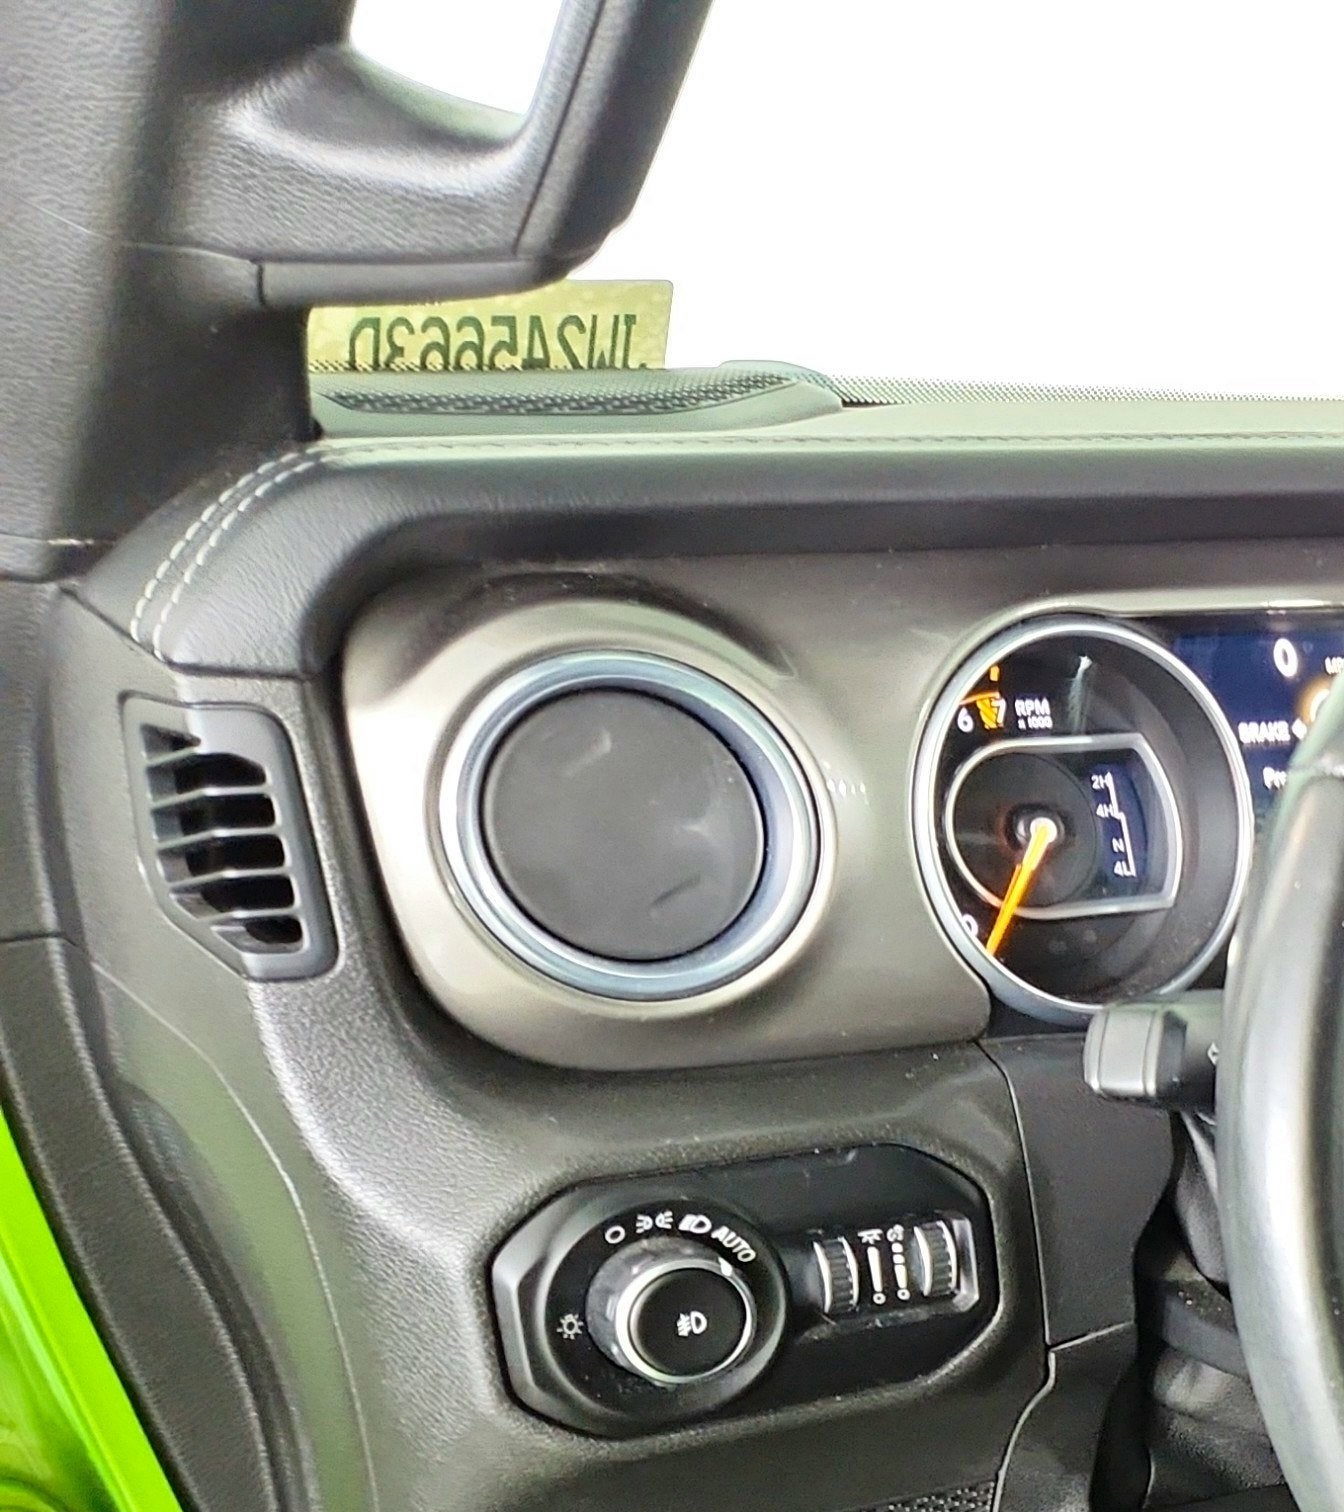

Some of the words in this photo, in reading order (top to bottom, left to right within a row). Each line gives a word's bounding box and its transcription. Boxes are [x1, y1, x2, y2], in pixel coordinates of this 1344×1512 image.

[1014, 697, 1051, 717] RPM
[957, 706, 974, 733] 6
[1238, 721, 1290, 743] BRAKE
[1111, 837, 1126, 854] N
[1113, 860, 1134, 878] 4L
[711, 1225, 756, 1262] AUTO
